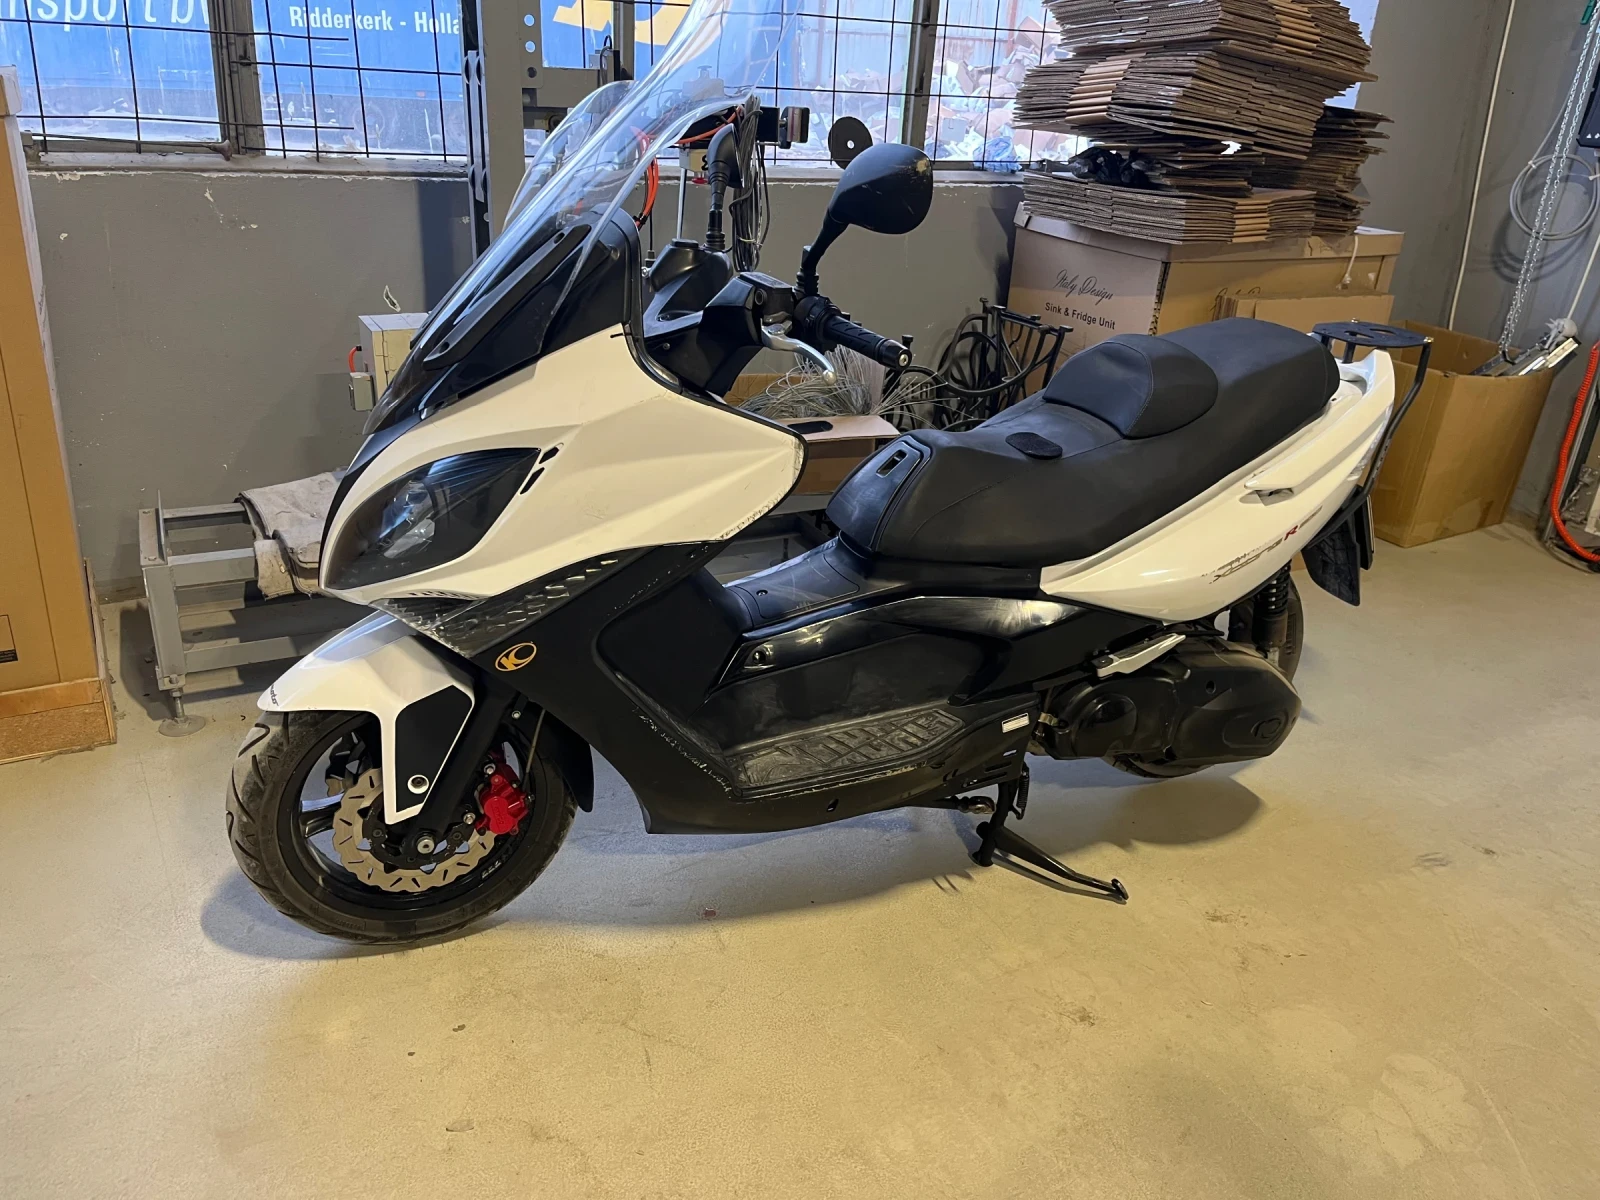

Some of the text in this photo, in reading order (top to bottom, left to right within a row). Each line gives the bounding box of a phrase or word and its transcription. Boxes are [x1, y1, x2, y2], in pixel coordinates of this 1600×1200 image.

[289, 6, 394, 31] Ridderkerk
[1053, 269, 1113, 305] Italy Design
[1045, 302, 1116, 330] Sink & Fridge Unit
